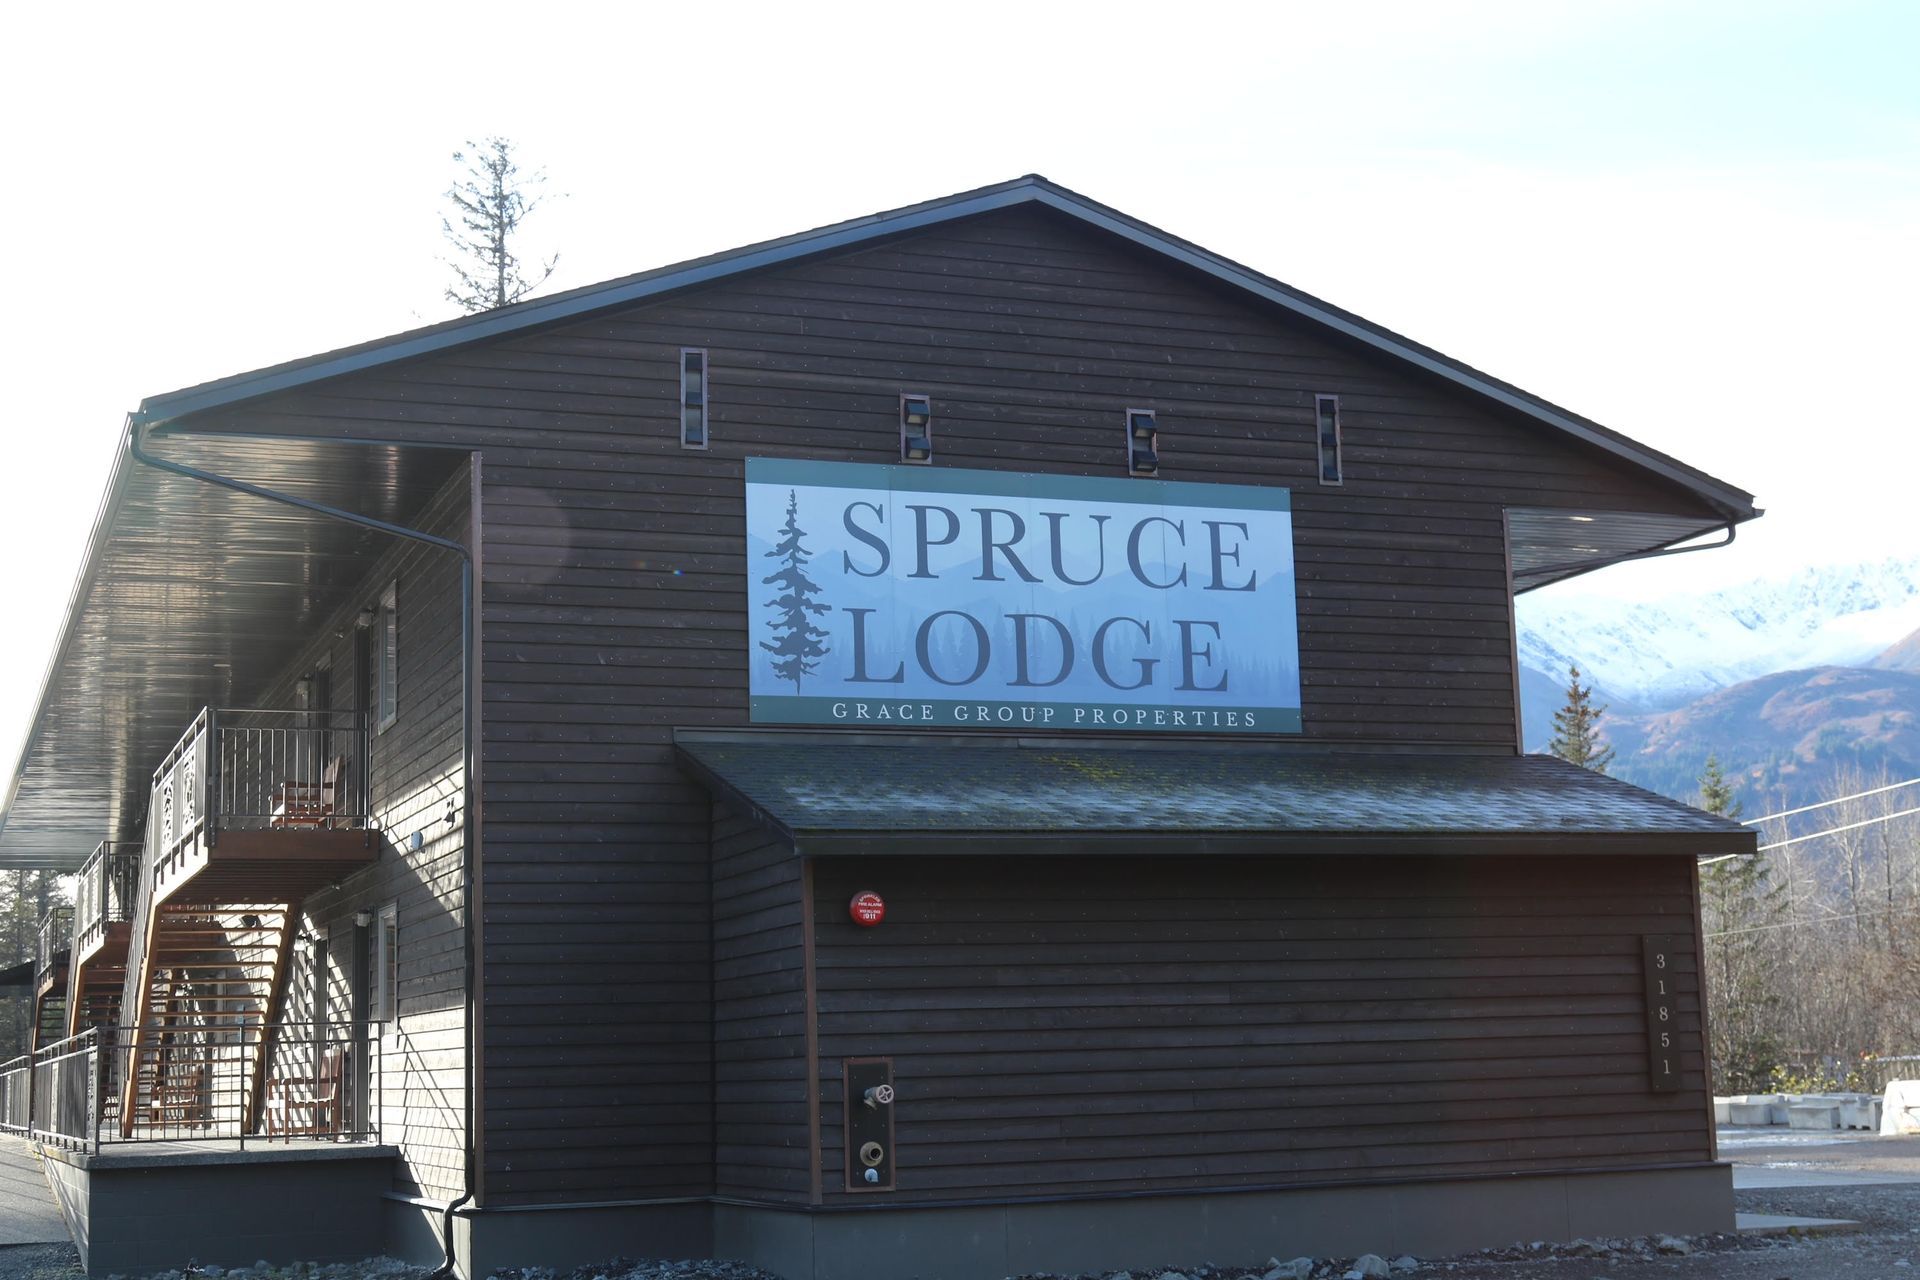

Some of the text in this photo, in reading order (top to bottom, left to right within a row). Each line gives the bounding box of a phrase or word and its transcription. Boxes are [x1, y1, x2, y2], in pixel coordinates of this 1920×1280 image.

[843, 501, 1257, 592] SPRUCE
[842, 608, 1229, 693] LODGE
[832, 703, 1255, 727] GRACE GROUP PROPERTIES
